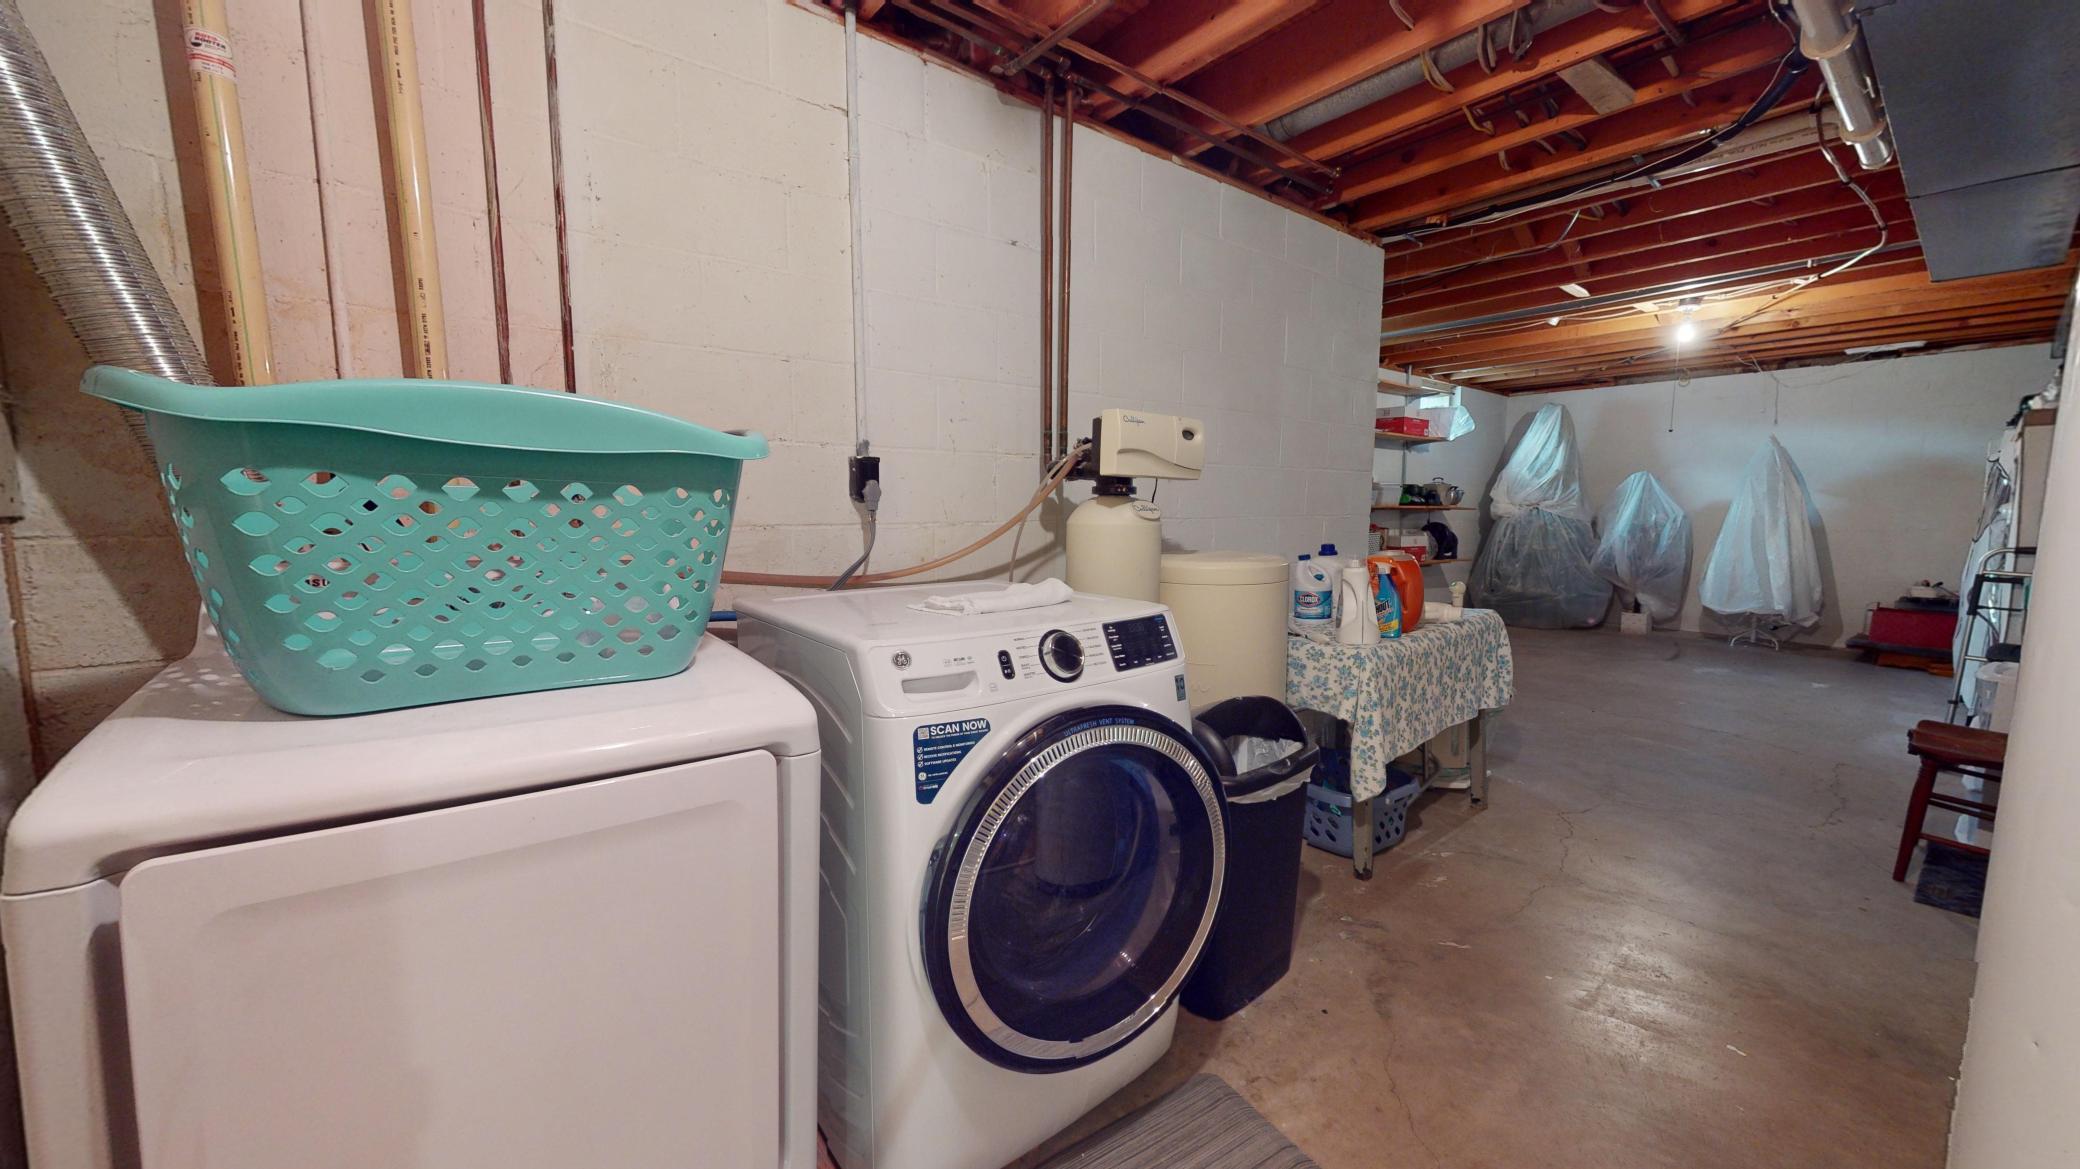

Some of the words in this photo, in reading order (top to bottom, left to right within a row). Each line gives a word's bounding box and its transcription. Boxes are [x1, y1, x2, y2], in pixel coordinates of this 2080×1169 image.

[1123, 415, 1145, 426] Culligan
[1299, 595, 1319, 603] CLOROX
[892, 651, 911, 669] GE
[930, 723, 959, 735] SCAN
[962, 720, 987, 731] NOW
[1063, 720, 1097, 736] ULTRAFRESH
